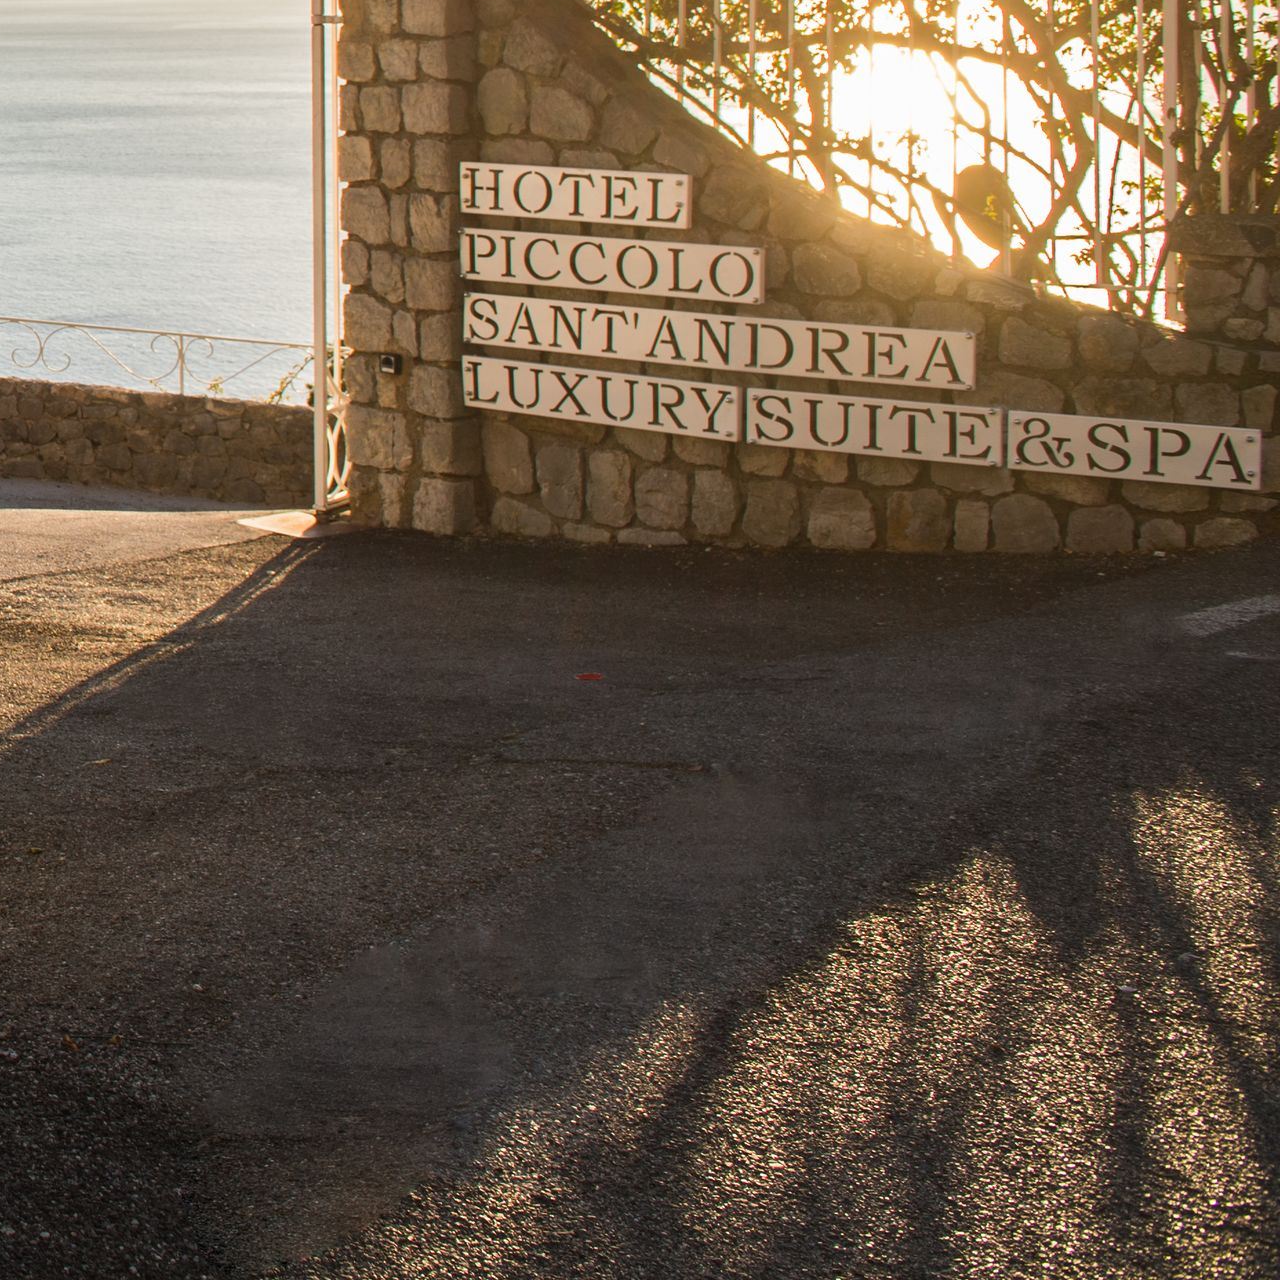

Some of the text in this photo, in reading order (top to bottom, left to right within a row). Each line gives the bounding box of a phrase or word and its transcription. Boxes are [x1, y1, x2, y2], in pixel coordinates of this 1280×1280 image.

[465, 167, 682, 223] HOTEL
[464, 232, 756, 298] PICCOLO
[468, 297, 967, 385] SANT'ANDREA
[466, 360, 730, 434] LUXURY
[753, 393, 993, 462] SUITE
